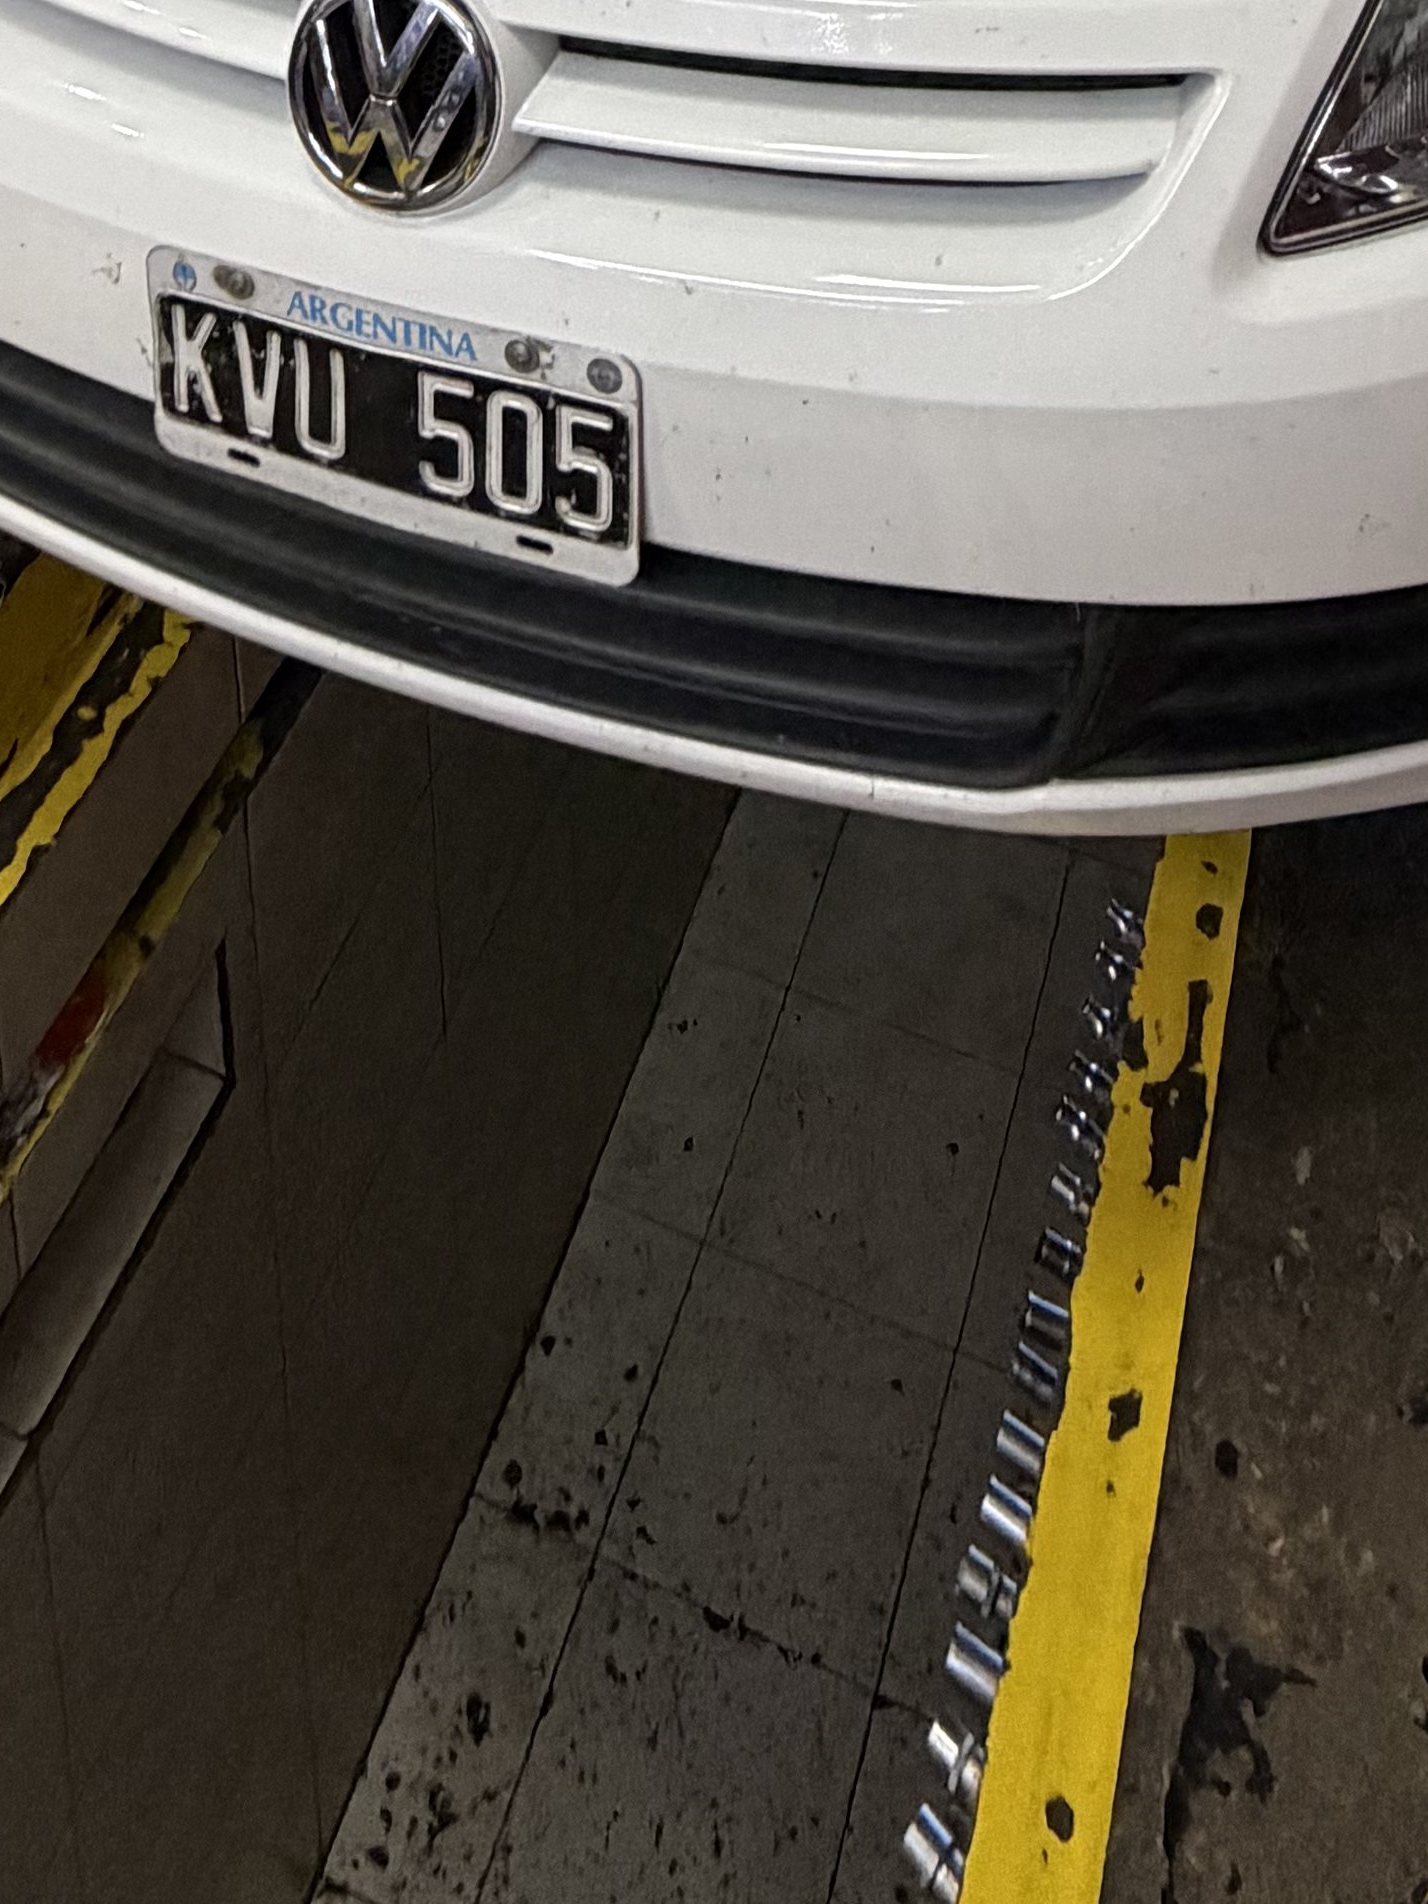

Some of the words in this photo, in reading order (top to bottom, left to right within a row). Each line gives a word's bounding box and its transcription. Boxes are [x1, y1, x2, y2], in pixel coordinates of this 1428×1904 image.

[286, 290, 477, 361] ARGENTINA
[171, 302, 346, 462] KVU
[417, 370, 615, 533] 505
